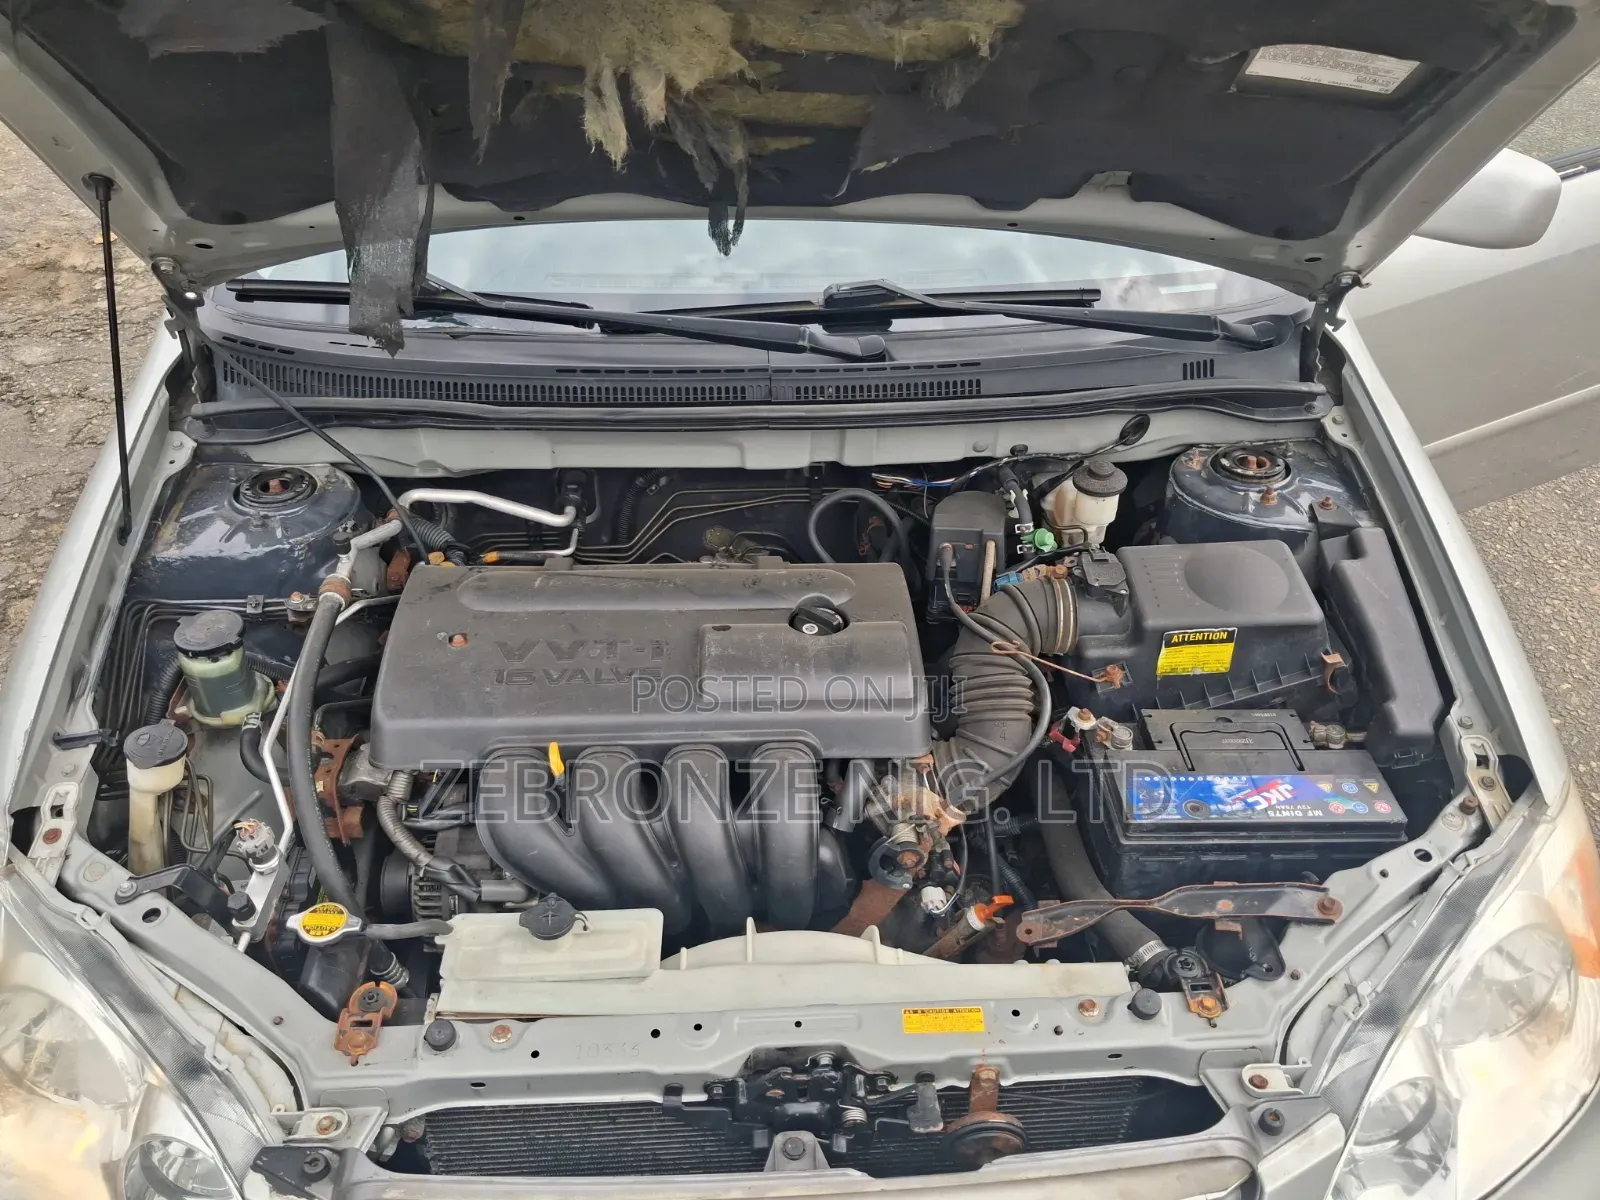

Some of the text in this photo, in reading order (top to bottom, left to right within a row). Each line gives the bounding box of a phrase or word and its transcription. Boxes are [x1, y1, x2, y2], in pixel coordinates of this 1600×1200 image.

[1356, 75, 1397, 87] CATALYST
[1171, 631, 1228, 643] ATTENTION
[494, 667, 664, 686] 16 VALVE
[1246, 783, 1294, 811] JKC
[1267, 809, 1323, 817] MF DIN75
